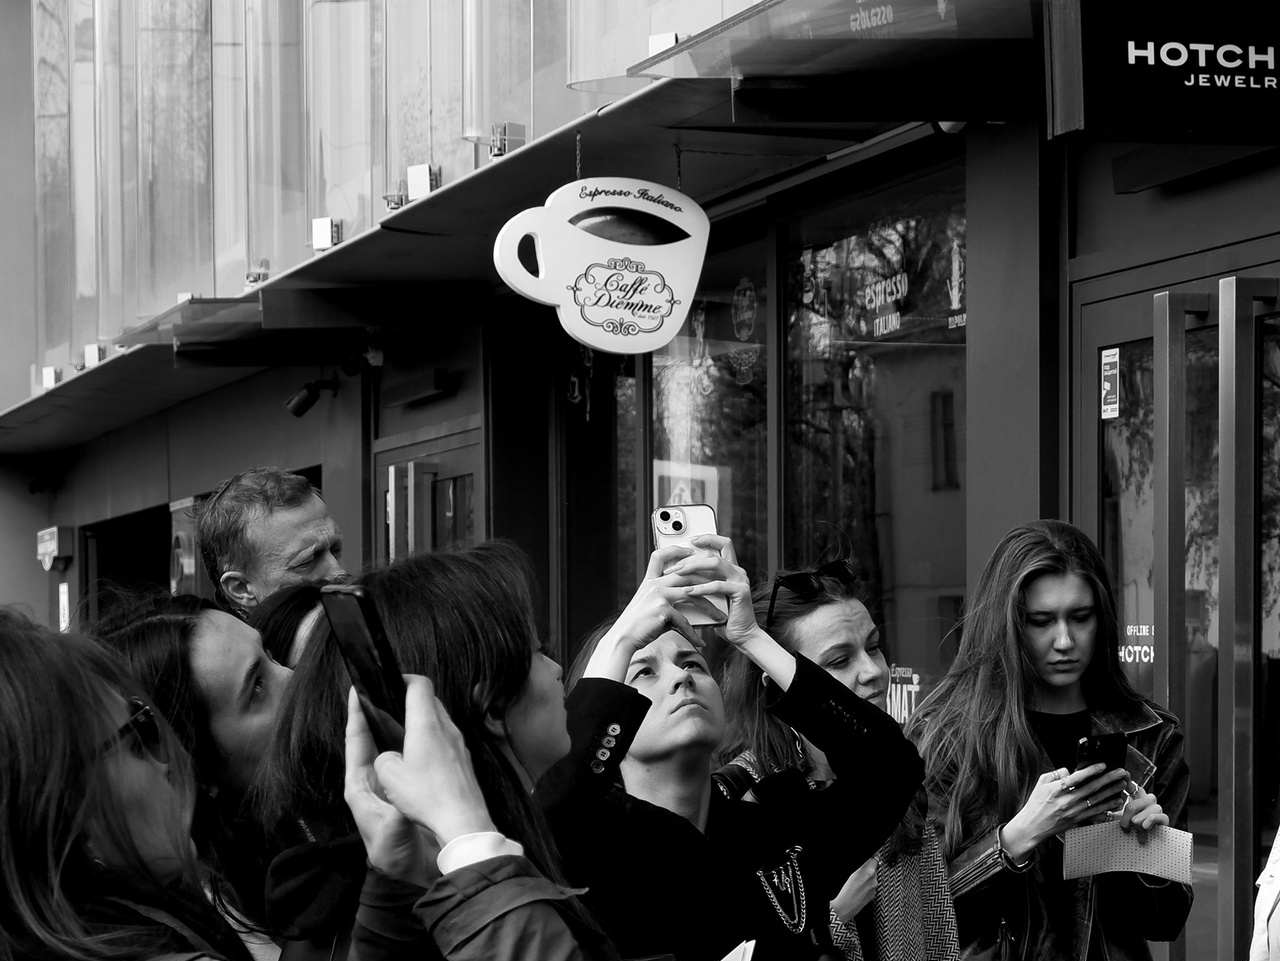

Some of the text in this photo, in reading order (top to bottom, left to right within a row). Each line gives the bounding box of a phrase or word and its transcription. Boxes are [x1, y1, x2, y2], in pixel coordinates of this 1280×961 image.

[578, 185, 684, 213] Espresso Italiano
[864, 271, 909, 314] espresso
[873, 311, 901, 338] ITALIANO
